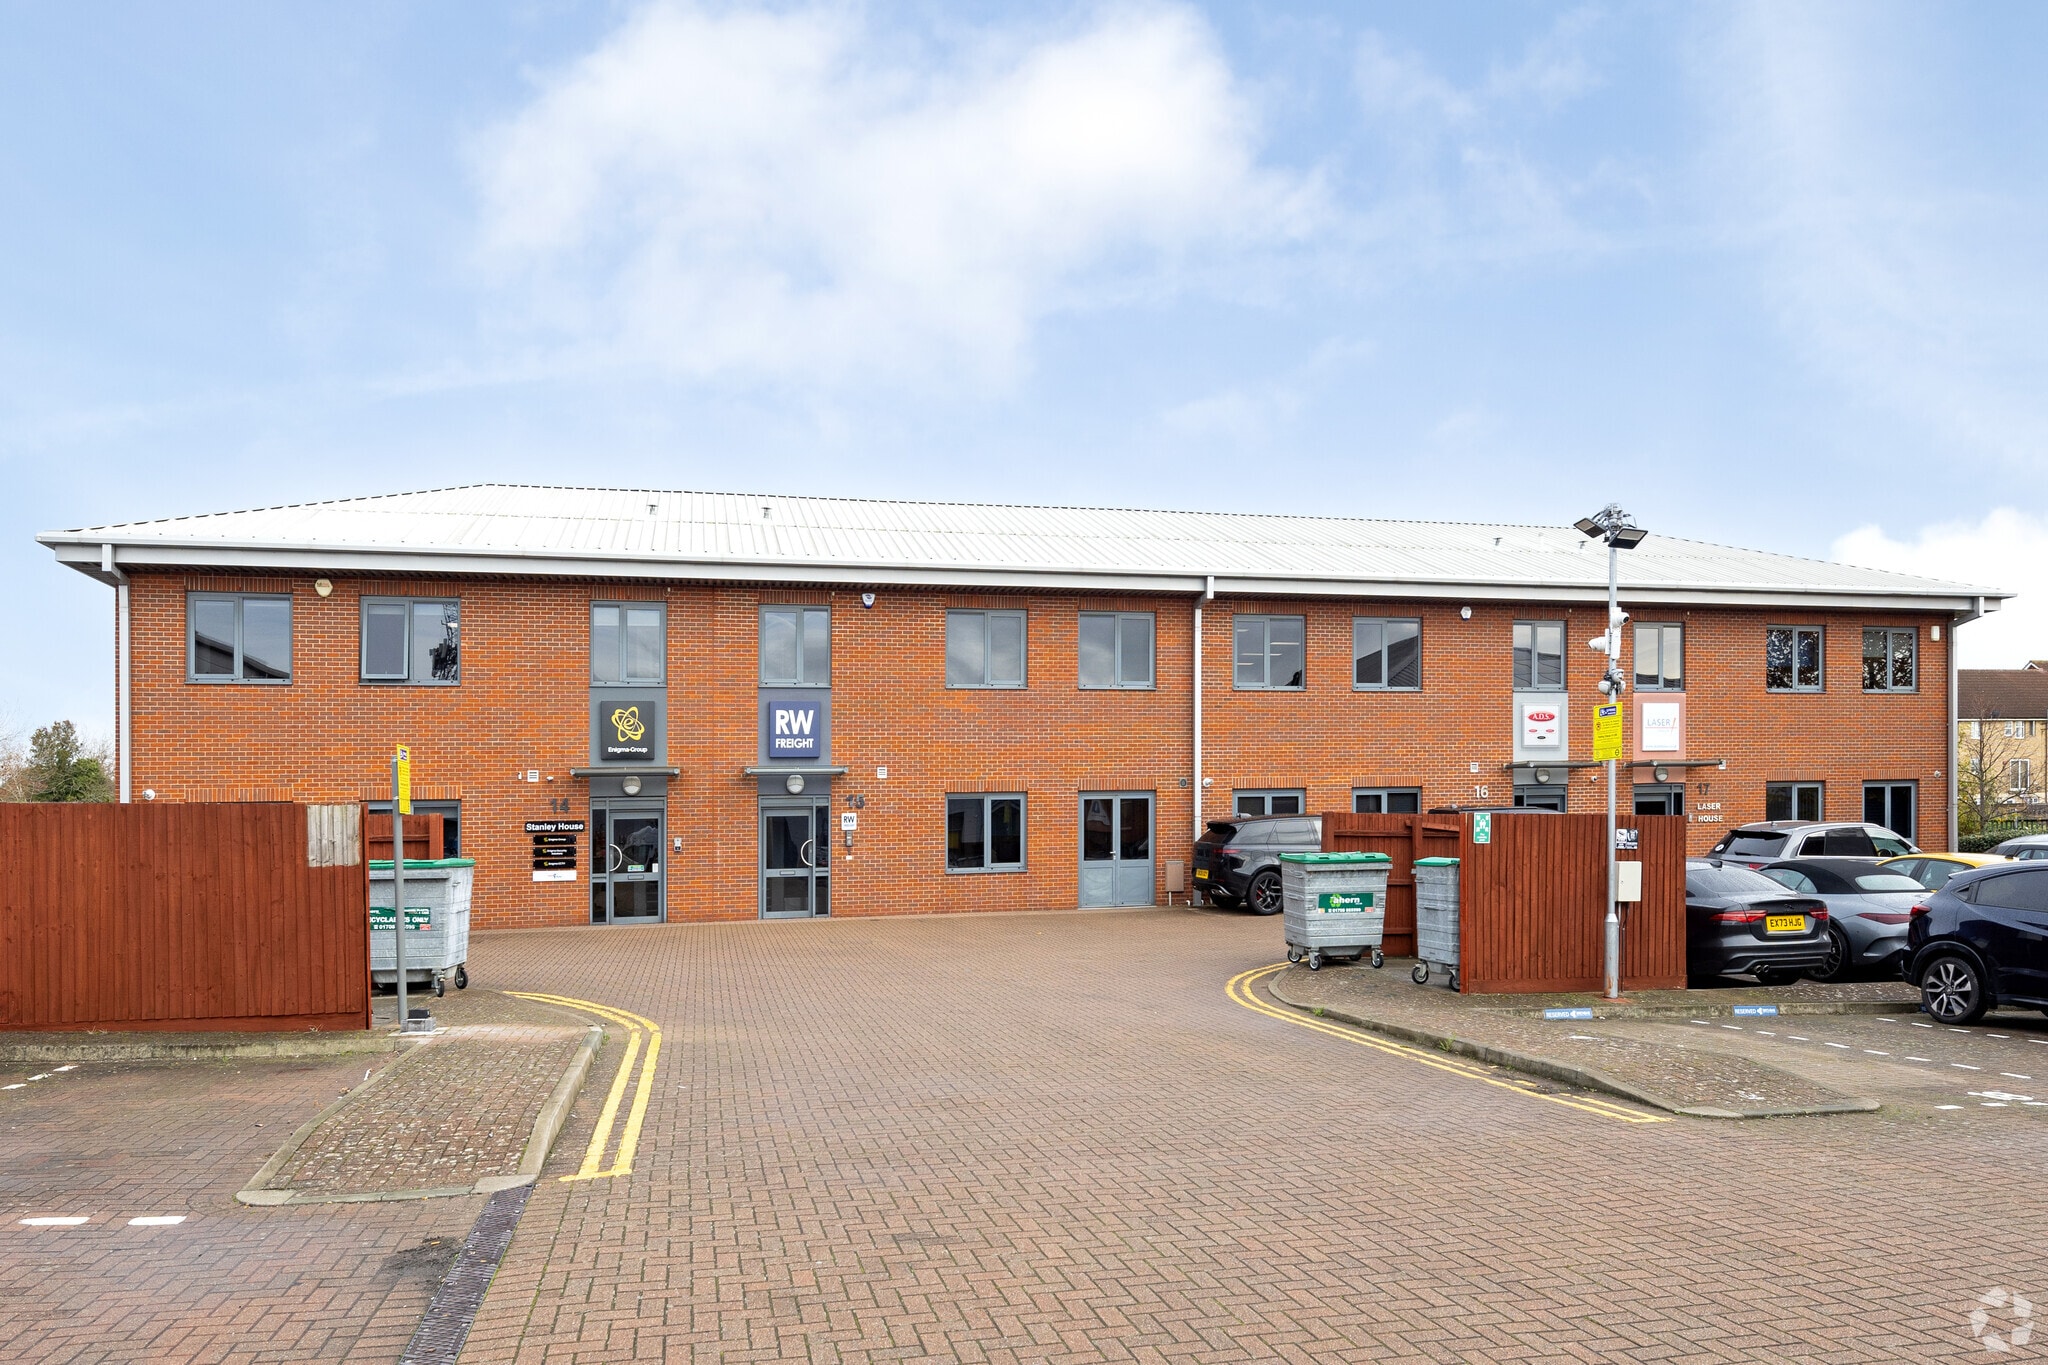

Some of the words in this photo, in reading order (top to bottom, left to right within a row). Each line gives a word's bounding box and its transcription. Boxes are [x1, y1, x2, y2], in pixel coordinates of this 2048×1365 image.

[775, 709, 815, 735] RW
[1647, 718, 1671, 727] LASER
[775, 738, 815, 749] FREIGHT
[1474, 785, 1489, 799] 16
[1697, 782, 1711, 796] 17
[550, 798, 570, 815] 14
[846, 794, 865, 809] 15
[1697, 802, 1721, 810] LASER
[843, 815, 855, 824] RW
[1698, 815, 1724, 823] HOUSE
[526, 823, 556, 832] Stanley
[558, 822, 584, 831] House
[1770, 918, 1788, 927] EX73
[1789, 918, 1802, 927] HJG
